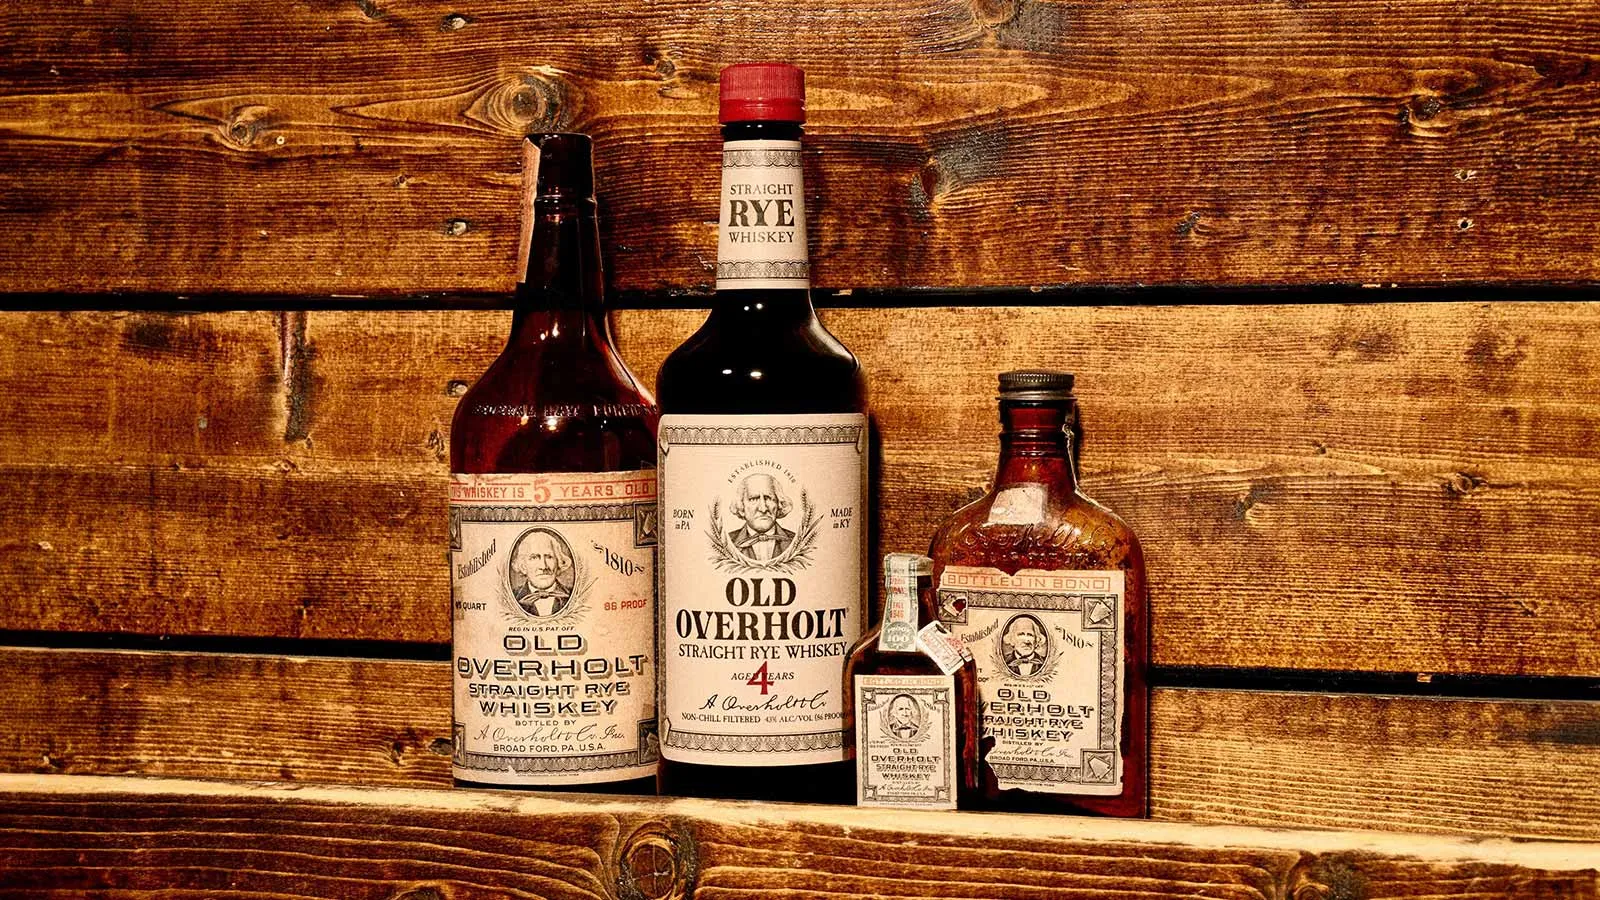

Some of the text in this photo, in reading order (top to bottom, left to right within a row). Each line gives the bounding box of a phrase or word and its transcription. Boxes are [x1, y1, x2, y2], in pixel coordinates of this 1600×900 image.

[730, 184, 794, 195] STRAIGHT
[728, 199, 795, 227] RYE
[728, 231, 795, 243] WHISKEY
[727, 459, 782, 483] ESTABLISHED
[462, 486, 507, 498] WHISKEY
[513, 486, 525, 498] IS
[533, 478, 551, 504] 5
[560, 485, 613, 497] YEARS
[625, 483, 649, 496] OLD
[673, 509, 695, 519] BORN
[830, 508, 853, 517] MADE
[680, 521, 691, 530] PA
[839, 518, 852, 528] KY
[457, 538, 497, 579] Established
[1028, 576, 1046, 588] IN
[1052, 578, 1105, 590] BOND
[725, 577, 797, 607] OLD
[462, 601, 487, 611] QUART
[620, 600, 648, 610] PROOF
[676, 608, 847, 641] OVERHOLT
[960, 618, 999, 644] Established
[503, 634, 586, 654] OLD
[678, 641, 847, 660] STRAIGHT RYE WHISKEY
[457, 654, 649, 680] OVERHOLT
[746, 661, 775, 695] 4
[469, 681, 630, 699] STRAIGHT RYE
[997, 688, 1051, 701] OLD
[480, 700, 617, 717] WHISKEY
[699, 693, 719, 710] A
[981, 702, 1094, 717] ERHOLT
[515, 719, 559, 727] BOTTLED
[681, 712, 722, 723] NON-CHILL
[722, 715, 761, 724] FILTERED
[778, 714, 814, 723] ALC/VOL
[1049, 718, 1084, 729] RYE
[474, 724, 490, 740] A
[493, 744, 526, 752] BROAD
[871, 755, 941, 763] OVERHOLT
[876, 764, 917, 772] STRAIGHT
[882, 772, 931, 780] WHISKEY
